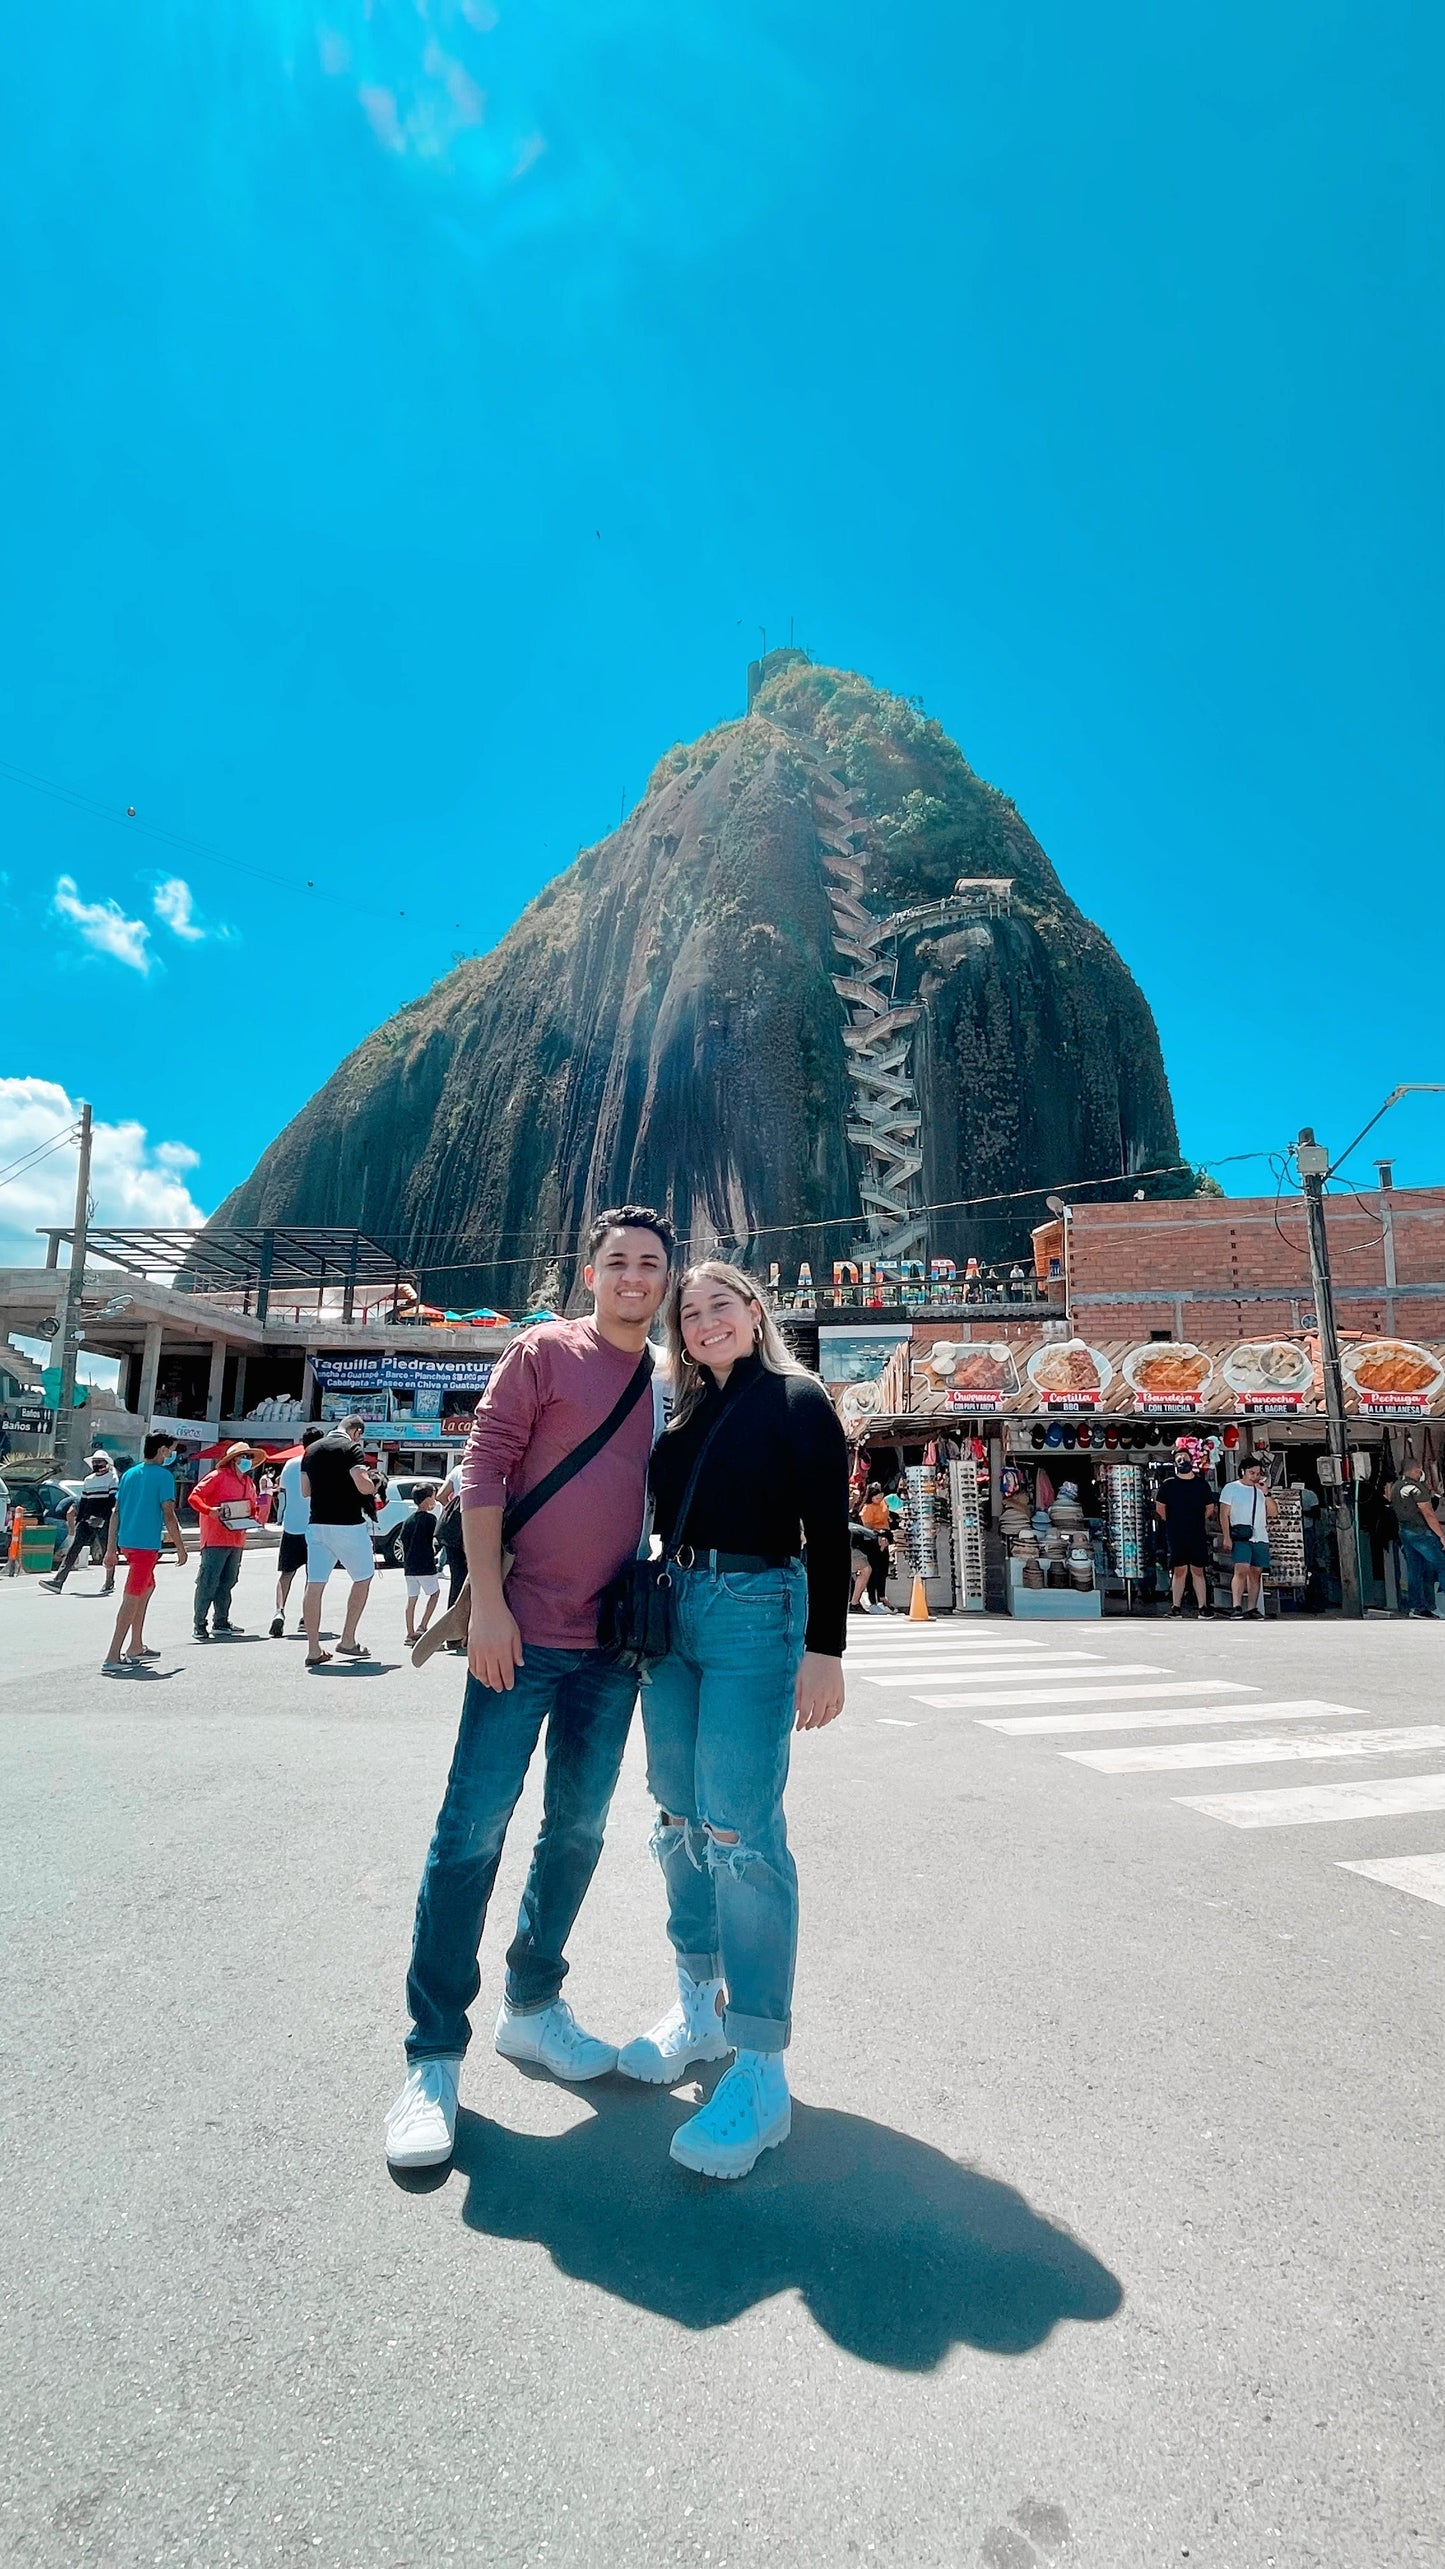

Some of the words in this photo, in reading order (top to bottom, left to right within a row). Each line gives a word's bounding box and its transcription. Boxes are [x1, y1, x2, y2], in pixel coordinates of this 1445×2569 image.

[767, 1261, 817, 1309] LA
[312, 1357, 377, 1372] Taquilla
[386, 1371, 409, 1379] Barco
[415, 1371, 450, 1381] Planchón
[327, 1379, 369, 1388] Cabalgata
[376, 1379, 403, 1388] Paseo
[417, 1380, 441, 1389] Chiva
[953, 1391, 997, 1402] Churrasco
[1050, 1392, 1093, 1403] Costilla
[1143, 1392, 1195, 1404] Bandeja
[1245, 1392, 1295, 1404] Sancocho
[1371, 1393, 1421, 1405] Pechuga
[1063, 1403, 1079, 1411] BBQ
[1149, 1404, 1161, 1412] CON
[1163, 1404, 1191, 1412] TRUCHA
[1254, 1404, 1263, 1412] DE
[1264, 1404, 1288, 1413] BAGRE
[1369, 1405, 1374, 1413] A
[1385, 1406, 1420, 1414] MILANESA
[2, 1420, 31, 1431] Baños
[442, 1419, 456, 1431] La
[457, 1422, 472, 1432] ca
